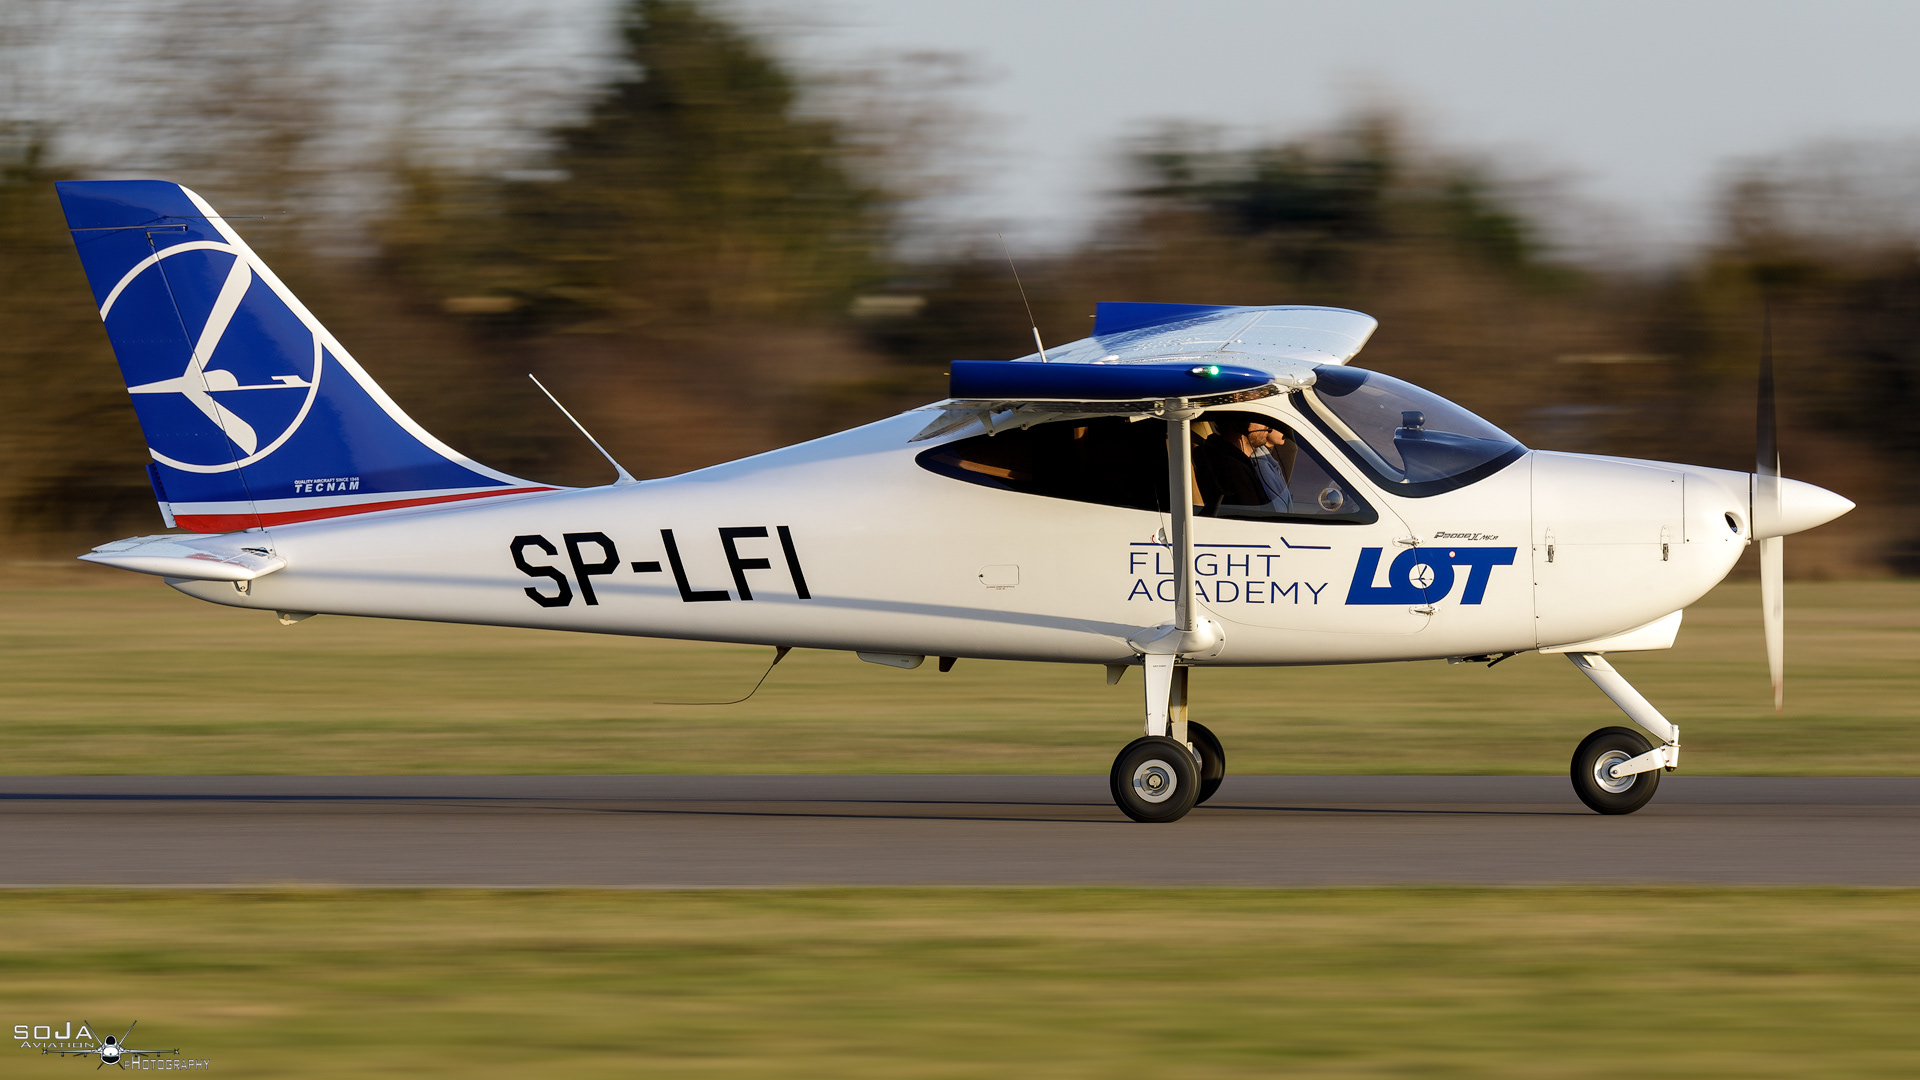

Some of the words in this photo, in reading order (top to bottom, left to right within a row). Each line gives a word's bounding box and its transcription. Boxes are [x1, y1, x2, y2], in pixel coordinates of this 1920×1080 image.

[294, 481, 360, 493] TECNAM
[509, 525, 812, 608] SP-LFI
[1129, 552, 1281, 577] FLGHT
[1344, 546, 1518, 605] LOT
[1127, 578, 1329, 605] ACADEMY
